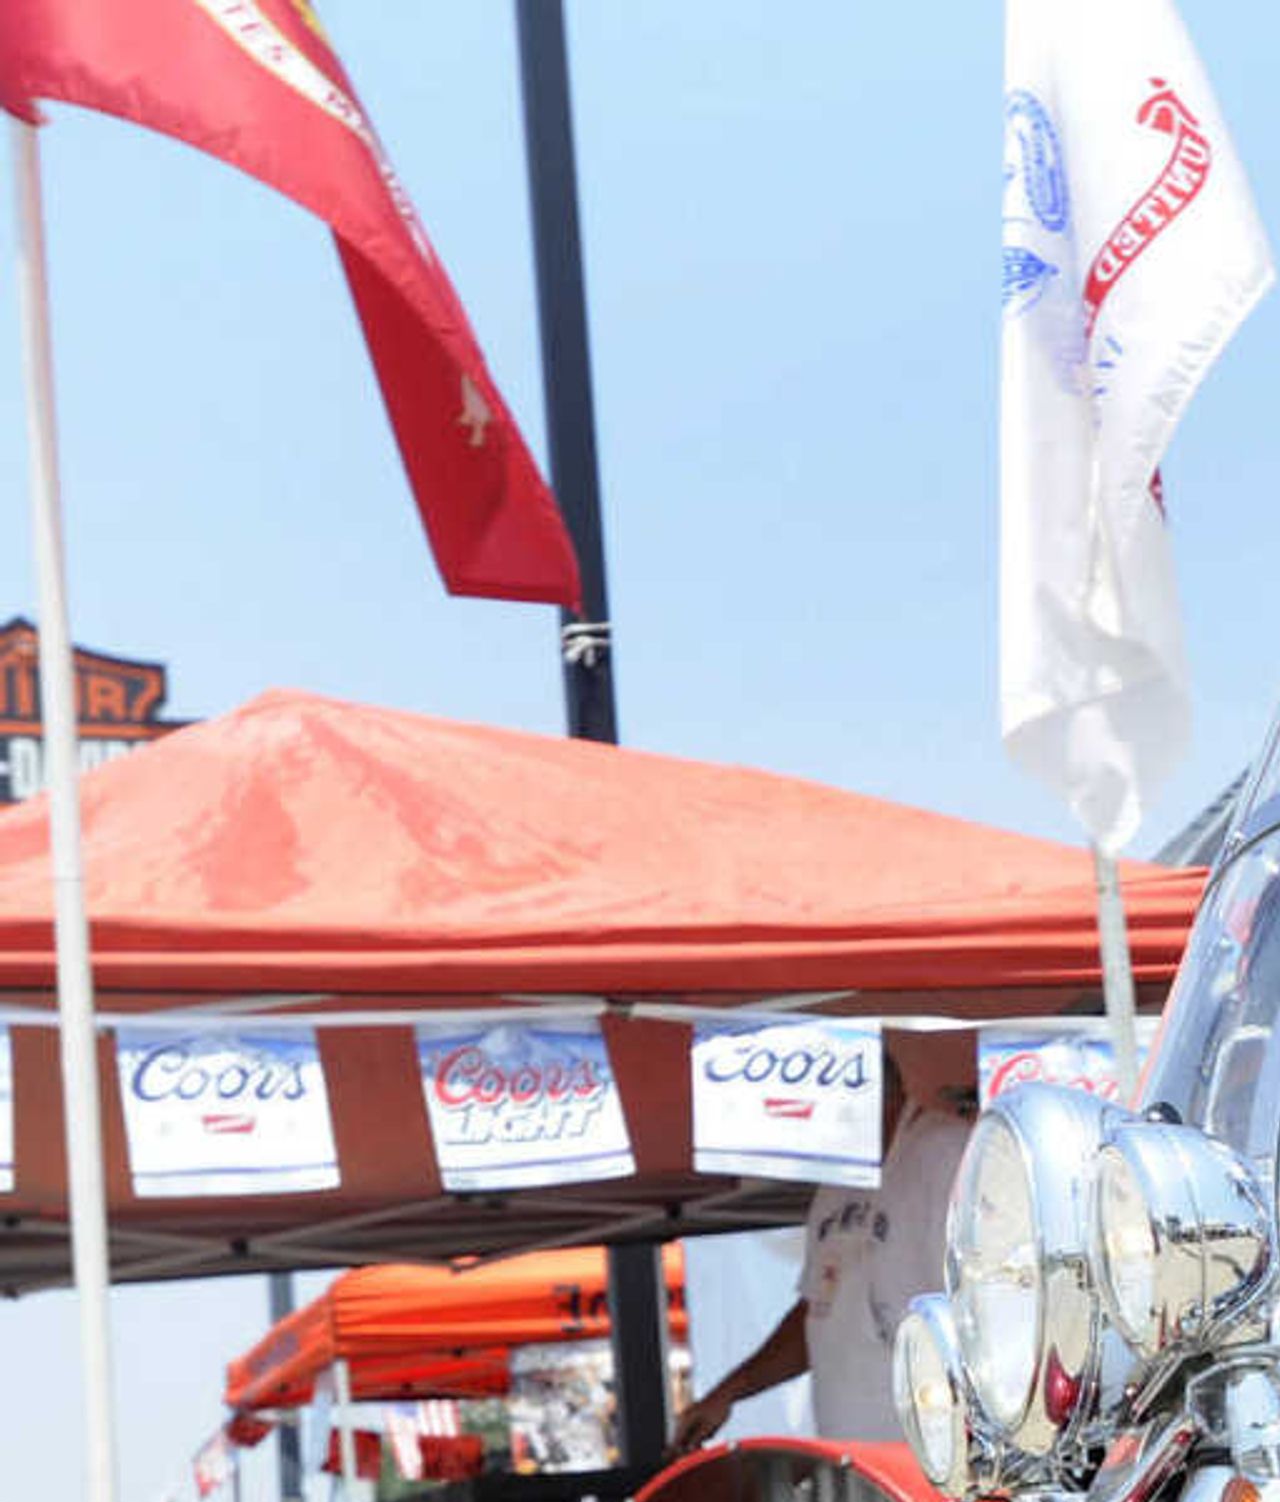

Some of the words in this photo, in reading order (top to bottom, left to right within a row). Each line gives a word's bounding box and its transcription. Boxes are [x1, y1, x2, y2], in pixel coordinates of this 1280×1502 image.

[132, 1035, 307, 1102] Coors
[433, 1046, 602, 1107] Coors
[704, 1040, 870, 1090] Coors
